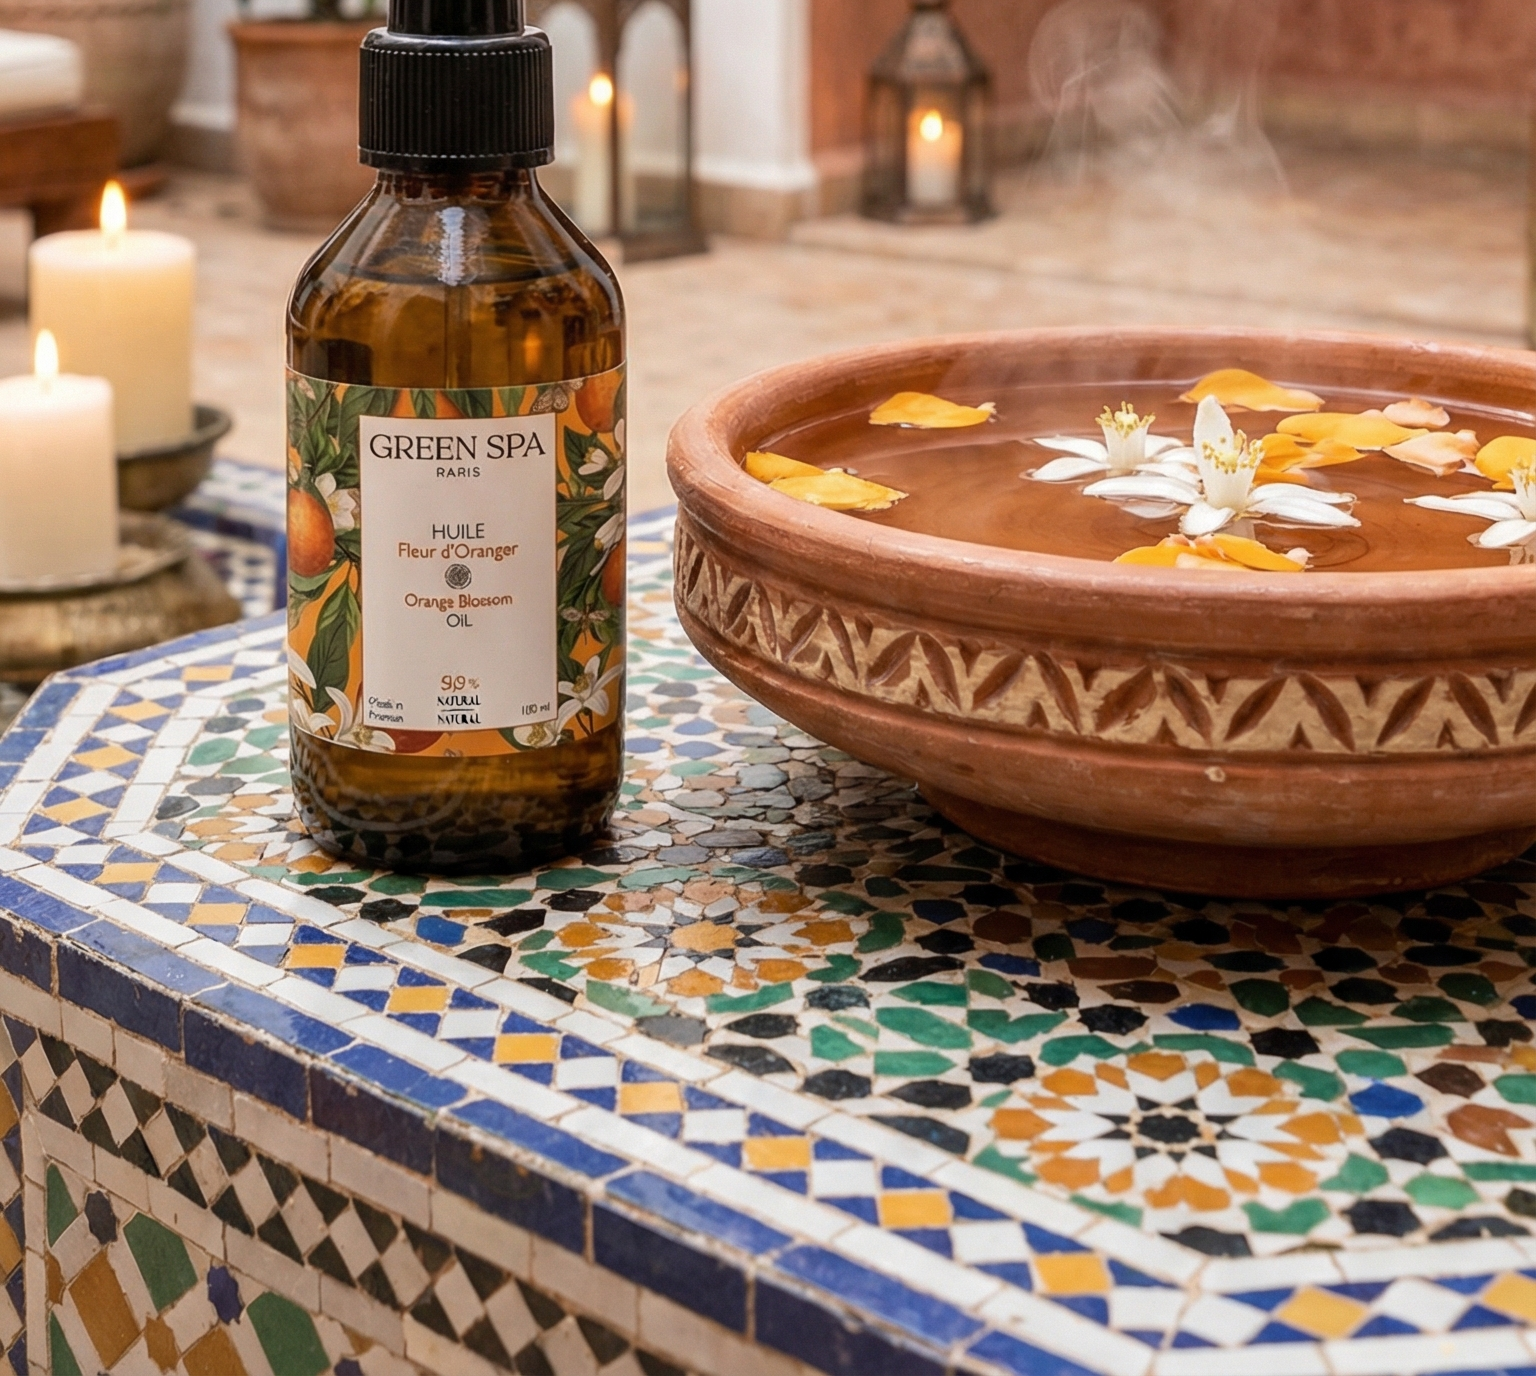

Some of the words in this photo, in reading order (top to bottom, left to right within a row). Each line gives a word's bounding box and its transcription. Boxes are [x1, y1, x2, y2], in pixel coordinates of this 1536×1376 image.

[369, 433, 478, 461] GREEN
[486, 431, 546, 460] SPA
[432, 522, 485, 540] HUILE
[398, 542, 437, 559] Fleur
[441, 543, 519, 562] d'Oranger
[404, 593, 454, 613] Orange
